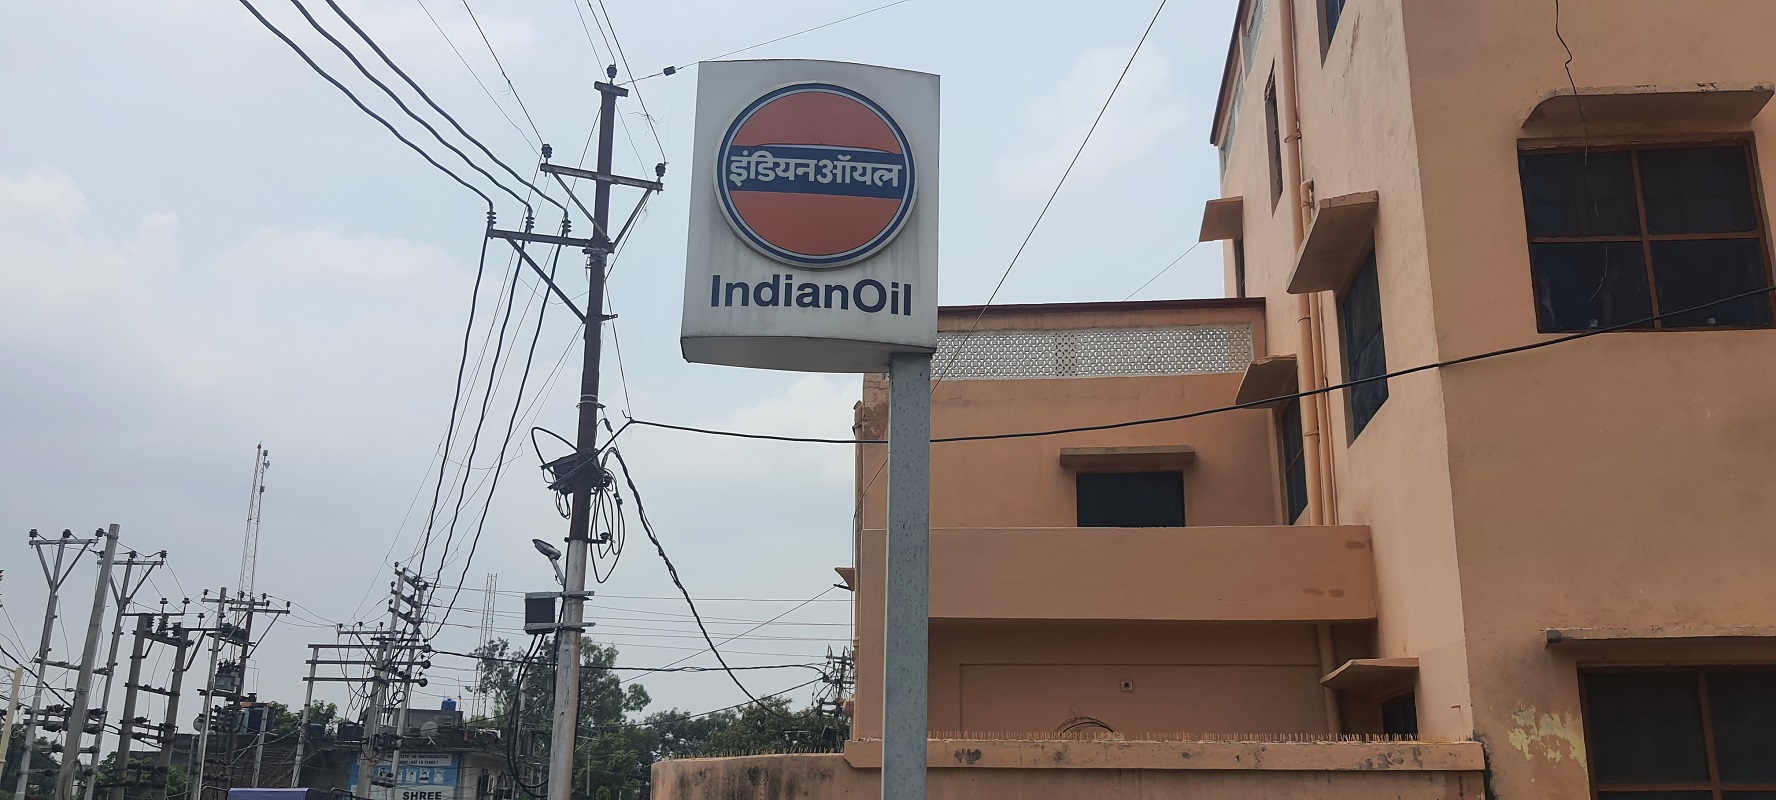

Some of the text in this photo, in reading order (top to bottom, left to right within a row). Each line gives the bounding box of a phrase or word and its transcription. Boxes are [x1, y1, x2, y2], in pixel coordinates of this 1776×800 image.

[729, 149, 903, 188] इंडियनऑयल
[710, 273, 913, 317] IndianOil
[402, 791, 442, 800] SHREE
